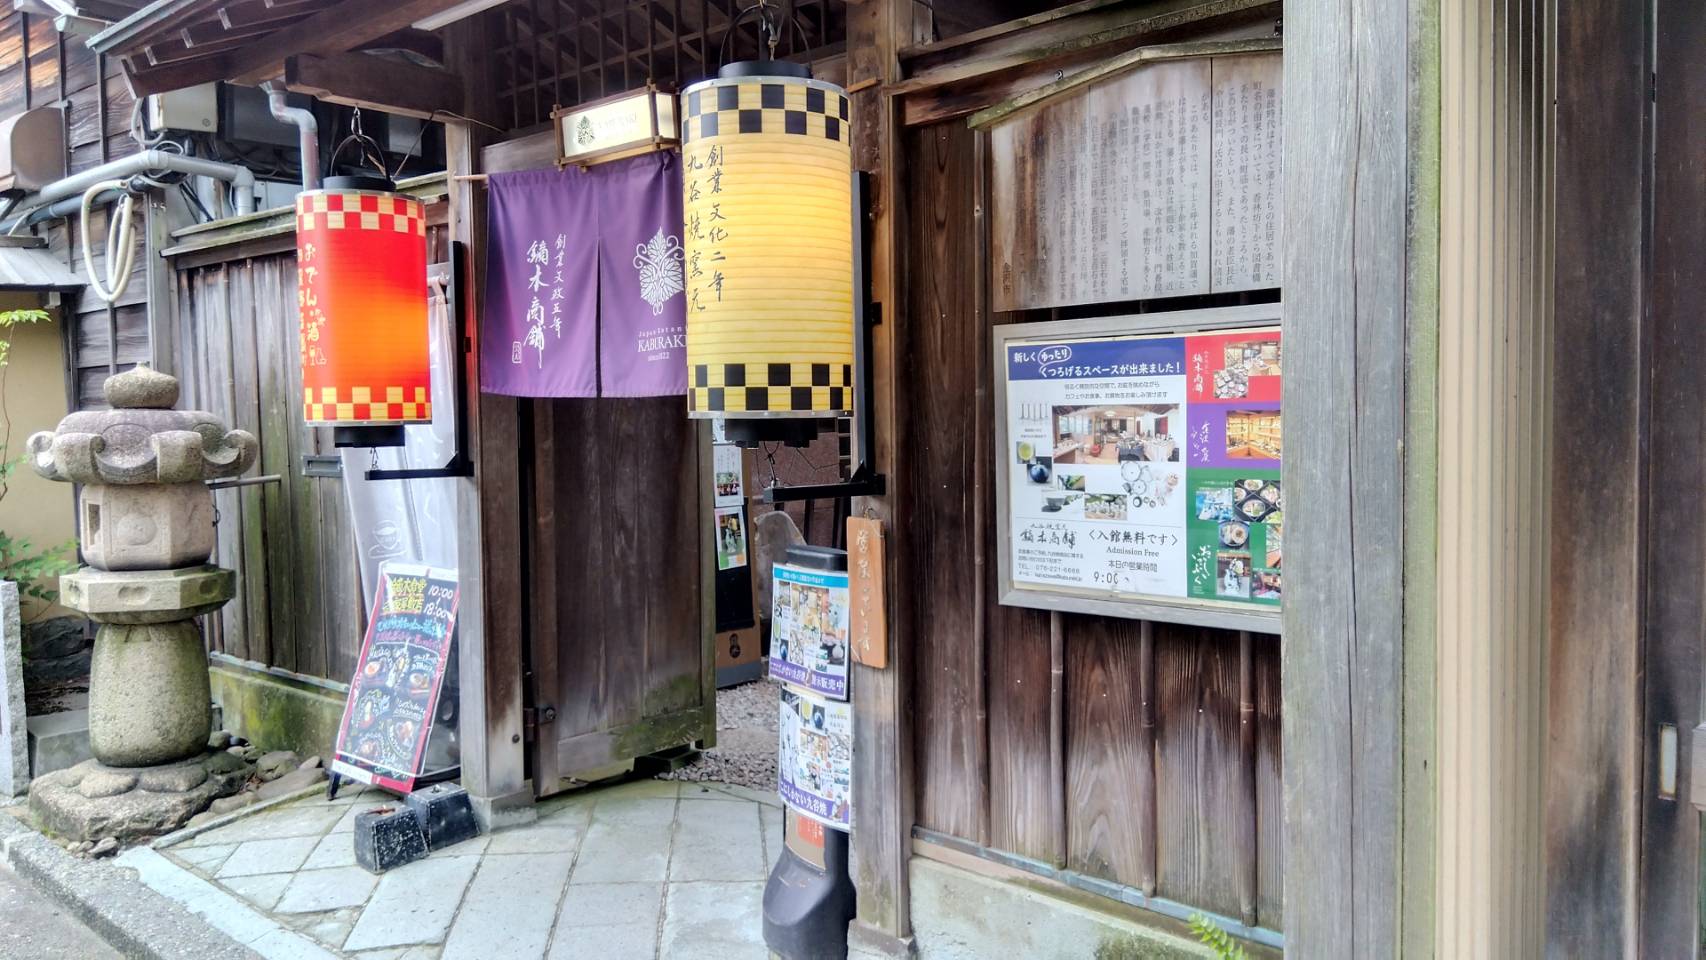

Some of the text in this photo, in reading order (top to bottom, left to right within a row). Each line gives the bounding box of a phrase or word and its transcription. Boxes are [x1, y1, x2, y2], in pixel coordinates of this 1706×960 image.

[706, 145, 728, 302] 創業文化二年
[638, 335, 687, 352] KABURAK
[1014, 348, 1067, 363] 新しく ゆったり
[1106, 546, 1160, 557] Admission Free
[428, 585, 453, 600] 10:00
